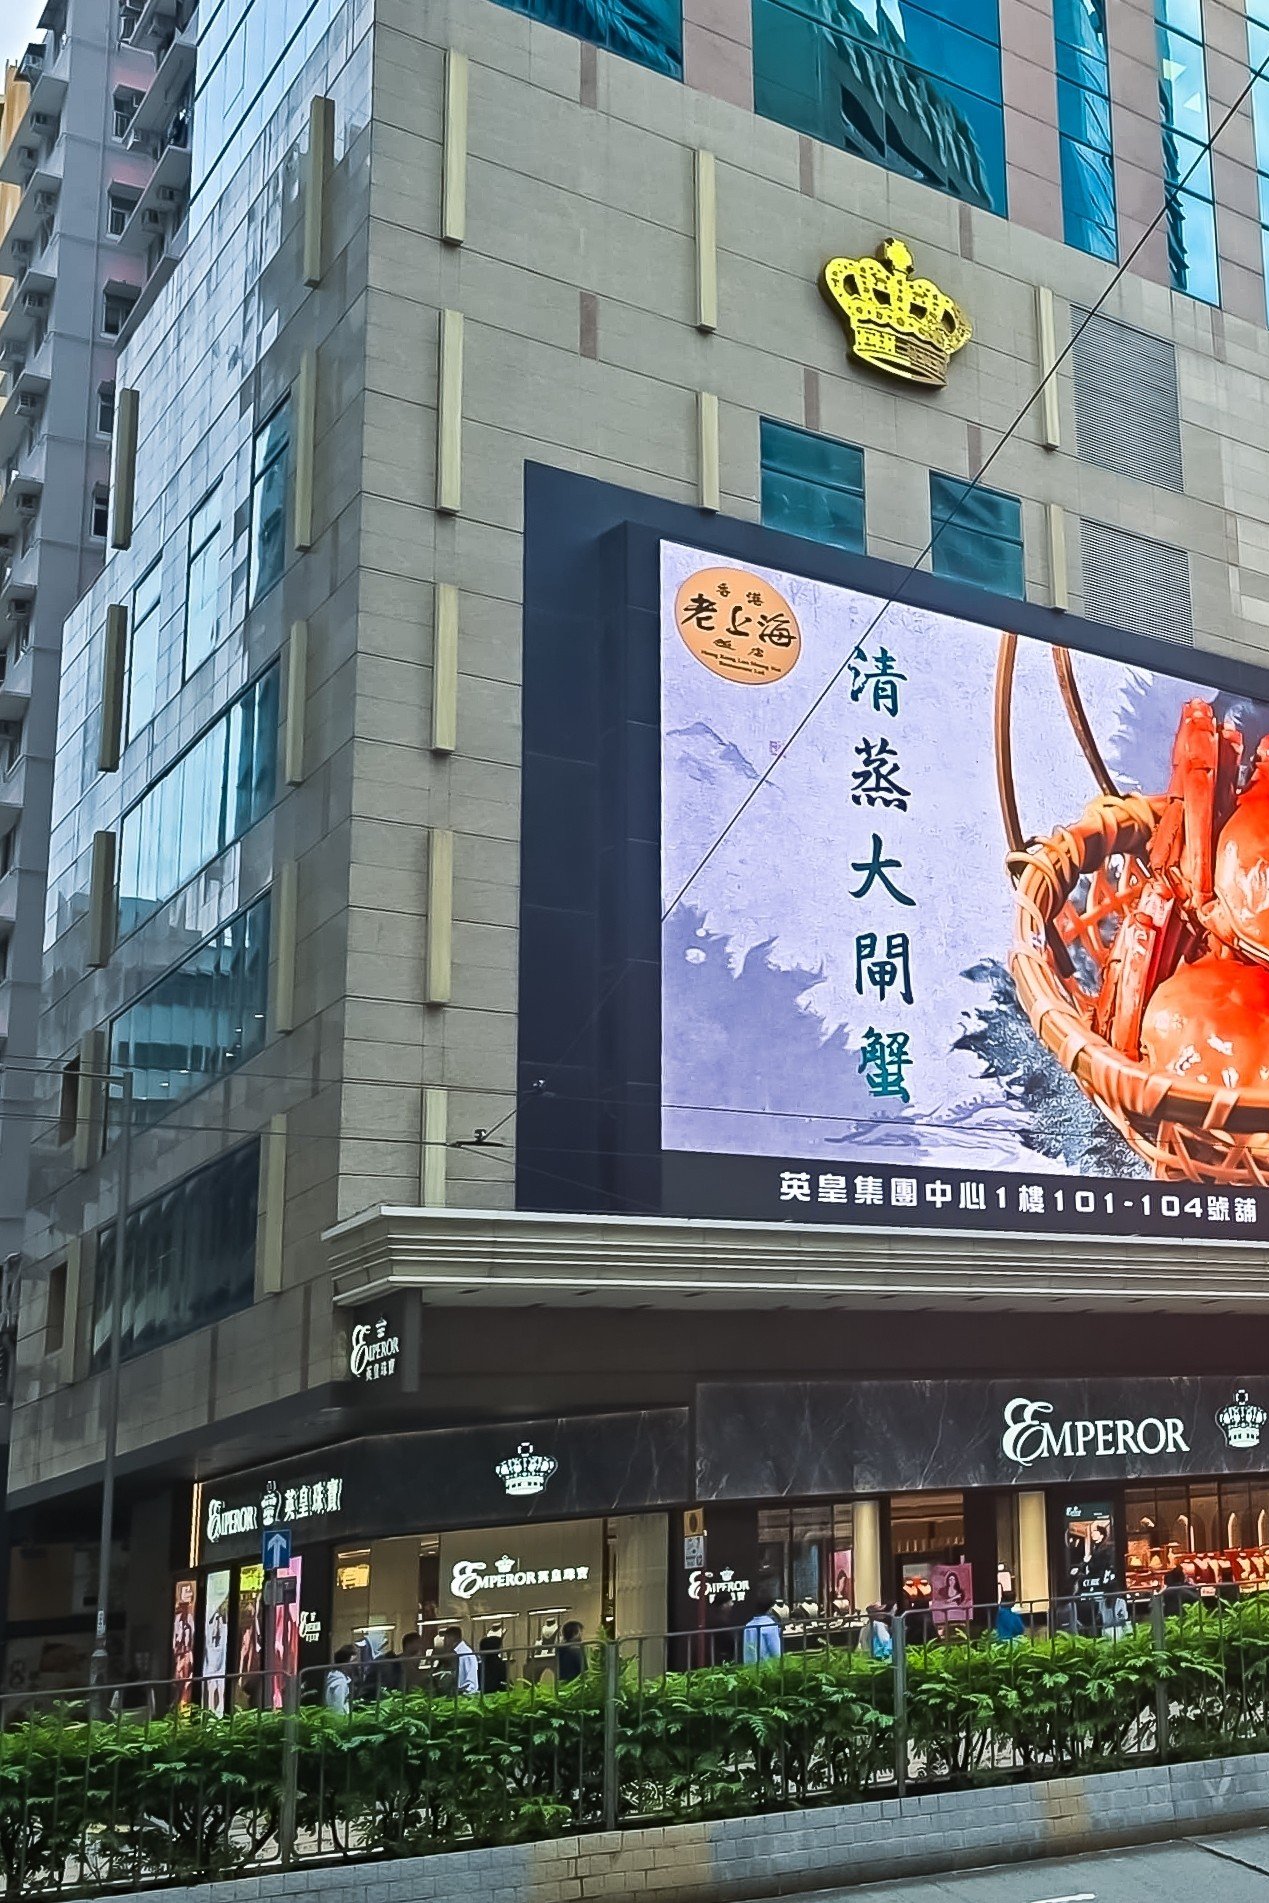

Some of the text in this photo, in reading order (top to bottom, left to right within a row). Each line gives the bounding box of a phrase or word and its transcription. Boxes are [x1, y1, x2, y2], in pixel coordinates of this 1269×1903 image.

[681, 593, 797, 648] 老上海
[848, 645, 917, 1104] 清蒸大閘蟹
[1001, 1397, 1191, 1467] EMPEROR
